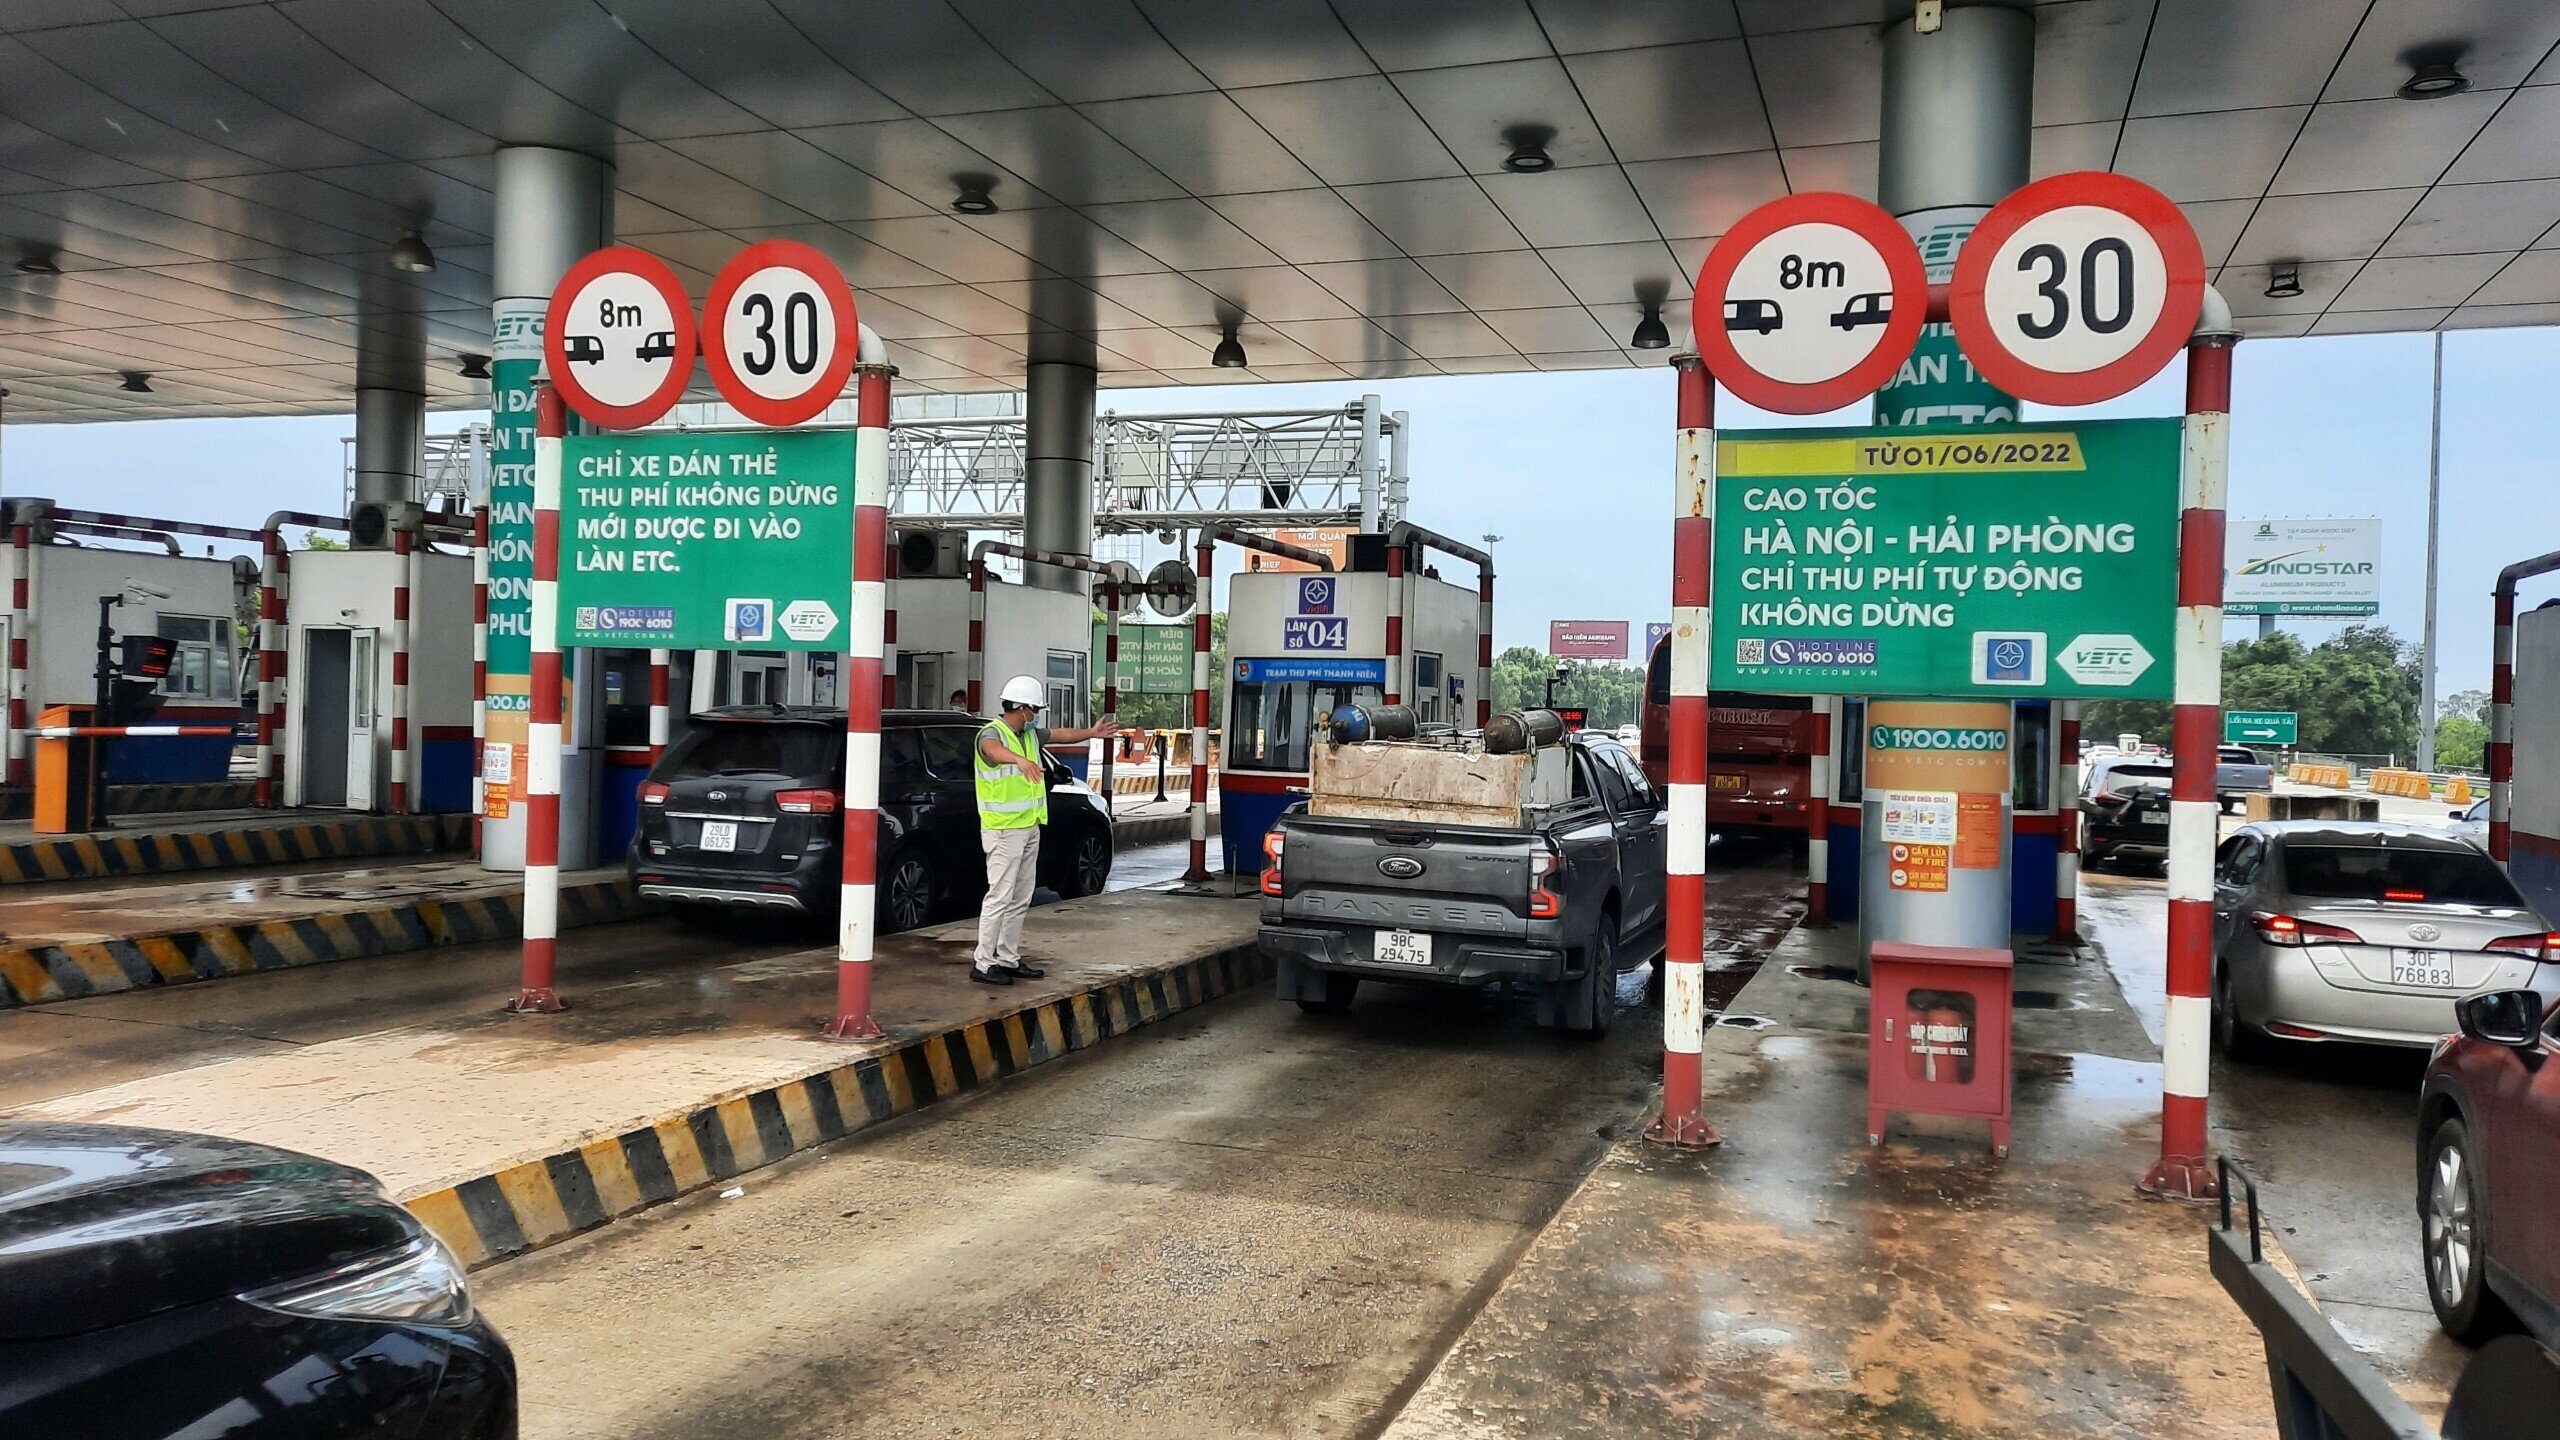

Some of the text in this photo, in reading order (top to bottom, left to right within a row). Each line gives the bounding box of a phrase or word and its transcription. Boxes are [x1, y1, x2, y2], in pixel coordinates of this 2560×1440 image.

[1778, 254, 1845, 290] 8m
[2016, 237, 2135, 340] 30
[599, 299, 642, 328] 8m
[742, 292, 818, 376] 30
[578, 446, 777, 477] CHỈ XE DÁN THẺ
[1865, 442, 2071, 467] TỪ 01/06/2022
[577, 480, 838, 507] THU PHÍ KHÔNG DỪNG
[1743, 476, 1877, 511] CAO TỐC
[577, 511, 801, 545] MỚI ĐƯỢC ĐI VÀO
[1743, 515, 2135, 563] HÀ NỘI - HẢI PHÒNG
[576, 544, 680, 572] LÀN ETC.
[2244, 559, 2373, 575] DINOSTAR
[1741, 558, 2083, 600] CHỈ THU PHÍ TỰ ĐỘNG
[618, 609, 673, 618] HOTLINE
[791, 614, 825, 624] VETC
[1741, 596, 1955, 628] KHÔNG DỪNG
[646, 618, 673, 629] 6010
[1289, 634, 1303, 648] SỐ
[1307, 621, 1345, 647] 04
[1798, 642, 1875, 651] HOTLINE
[1797, 651, 1875, 664] 1900 6010
[2076, 651, 2133, 665] VETC
[1289, 669, 1305, 677] THU
[1323, 669, 1353, 678] THANH
[1736, 667, 1878, 677] WWW.VETC.COM.VN
[1892, 728, 2006, 750] 1900.6010
[709, 792, 727, 800] KIA
[710, 825, 730, 837] 29LD
[1388, 861, 1413, 874] Ford
[1926, 858, 1946, 867] FIRE
[1303, 895, 1505, 927] RANGER
[1390, 934, 1415, 948] 98C
[1380, 949, 1425, 963] 294.75
[2406, 951, 2437, 966] 30F
[2395, 967, 2451, 985] 768.83
